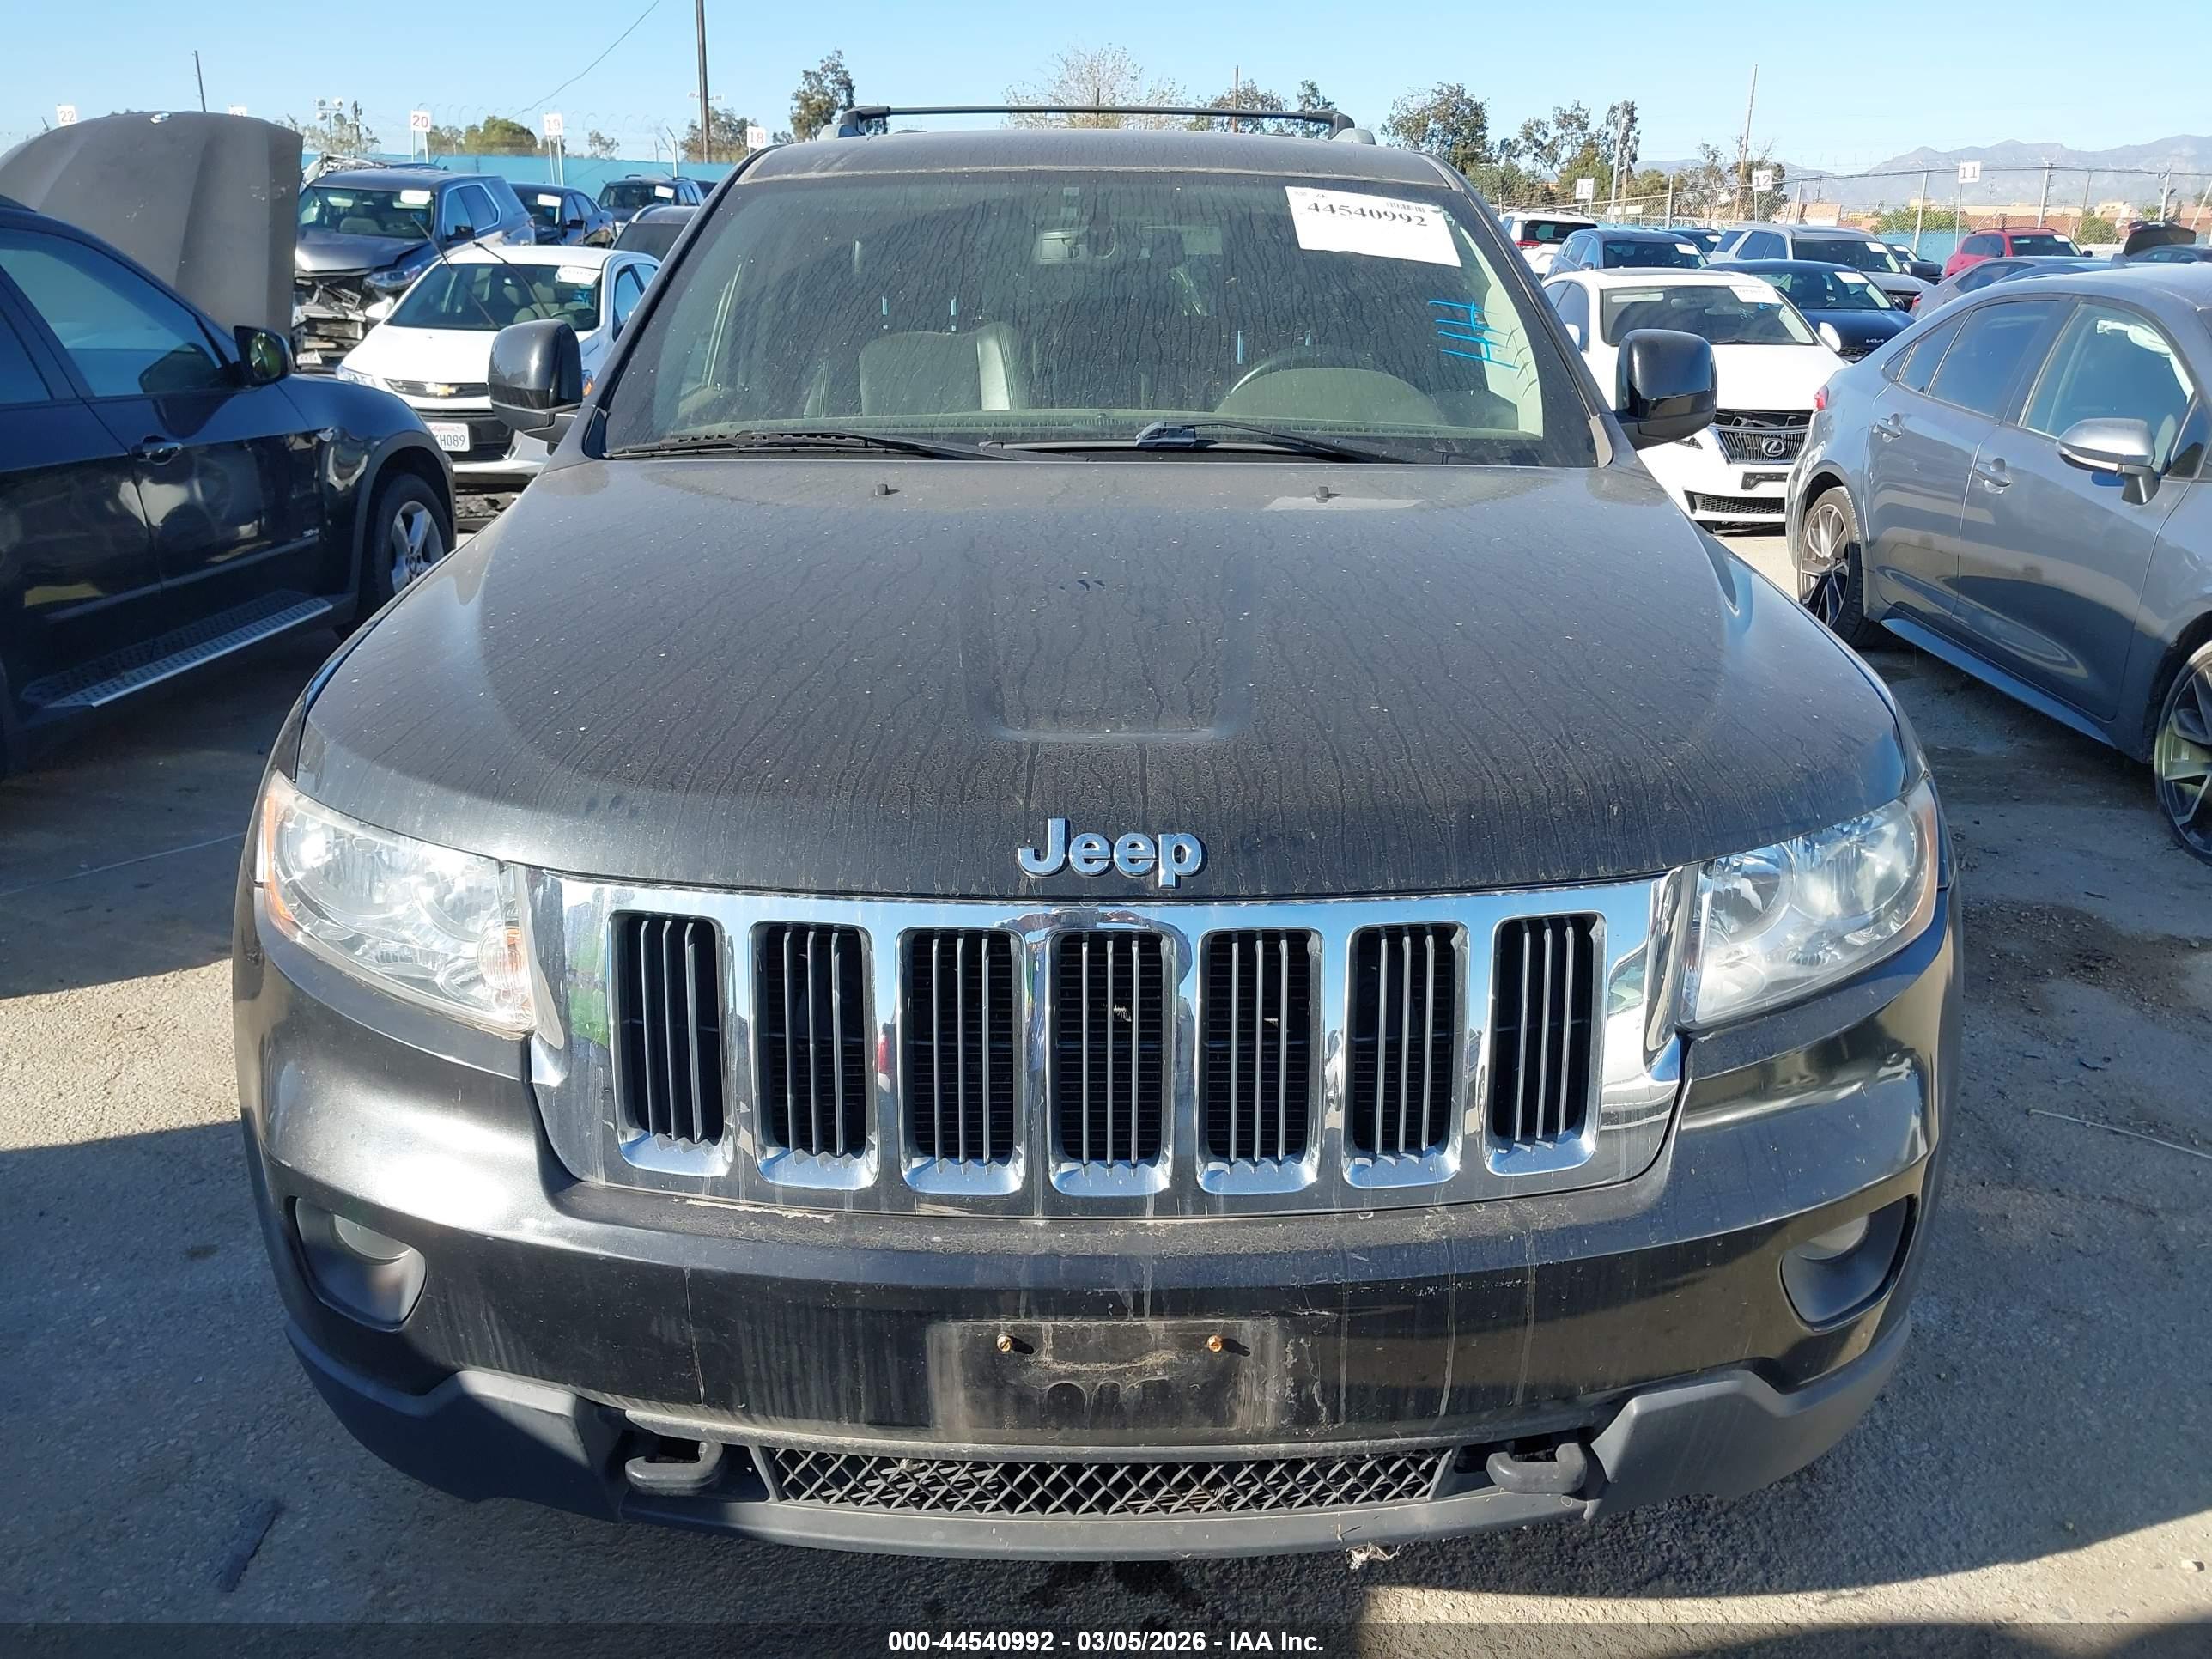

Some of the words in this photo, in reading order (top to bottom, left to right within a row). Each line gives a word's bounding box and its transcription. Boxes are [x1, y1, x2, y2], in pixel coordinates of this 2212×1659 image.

[60, 110, 75, 123] 22
[412, 114, 428, 128] 20
[546, 118, 561, 131] 19
[1960, 167, 1978, 179] 11
[1753, 174, 1771, 188] 12
[1307, 202, 1428, 227] 44540992
[435, 433, 465, 447] H089
[1017, 817, 1204, 890] Jeep
